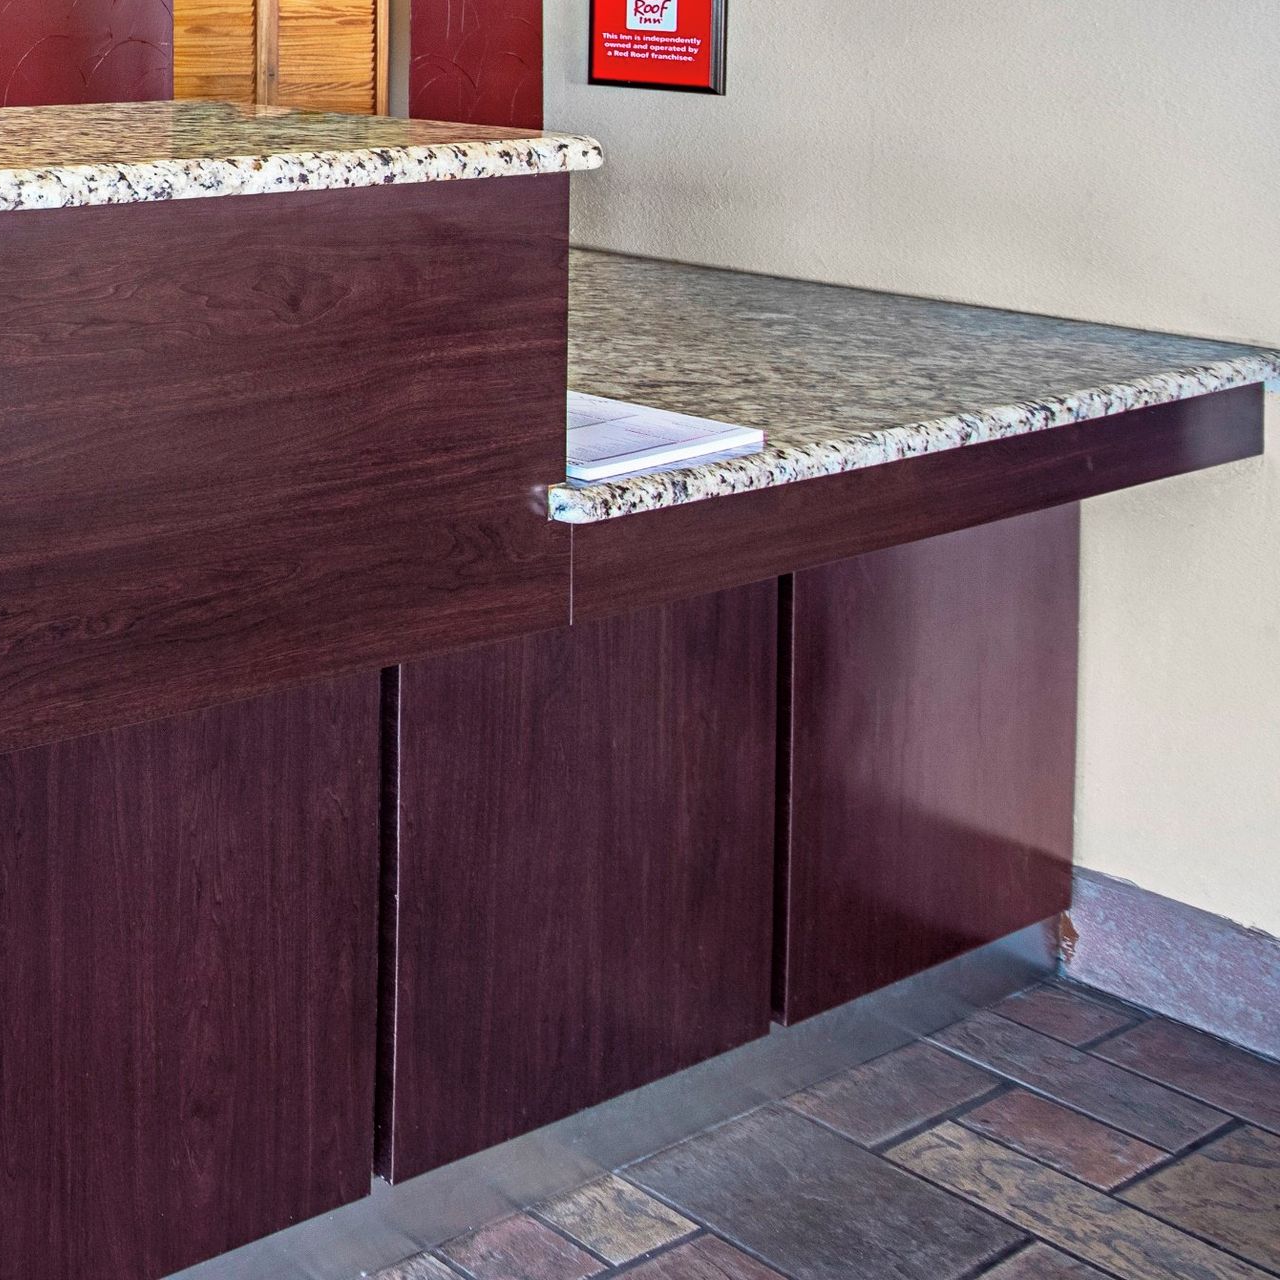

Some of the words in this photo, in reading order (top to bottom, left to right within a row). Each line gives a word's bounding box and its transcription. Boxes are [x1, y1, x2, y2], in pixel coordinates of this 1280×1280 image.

[634, 0, 671, 17] Roof
[643, 36, 701, 45] independently
[688, 46, 698, 54] by
[651, 52, 695, 61] franchisee.
